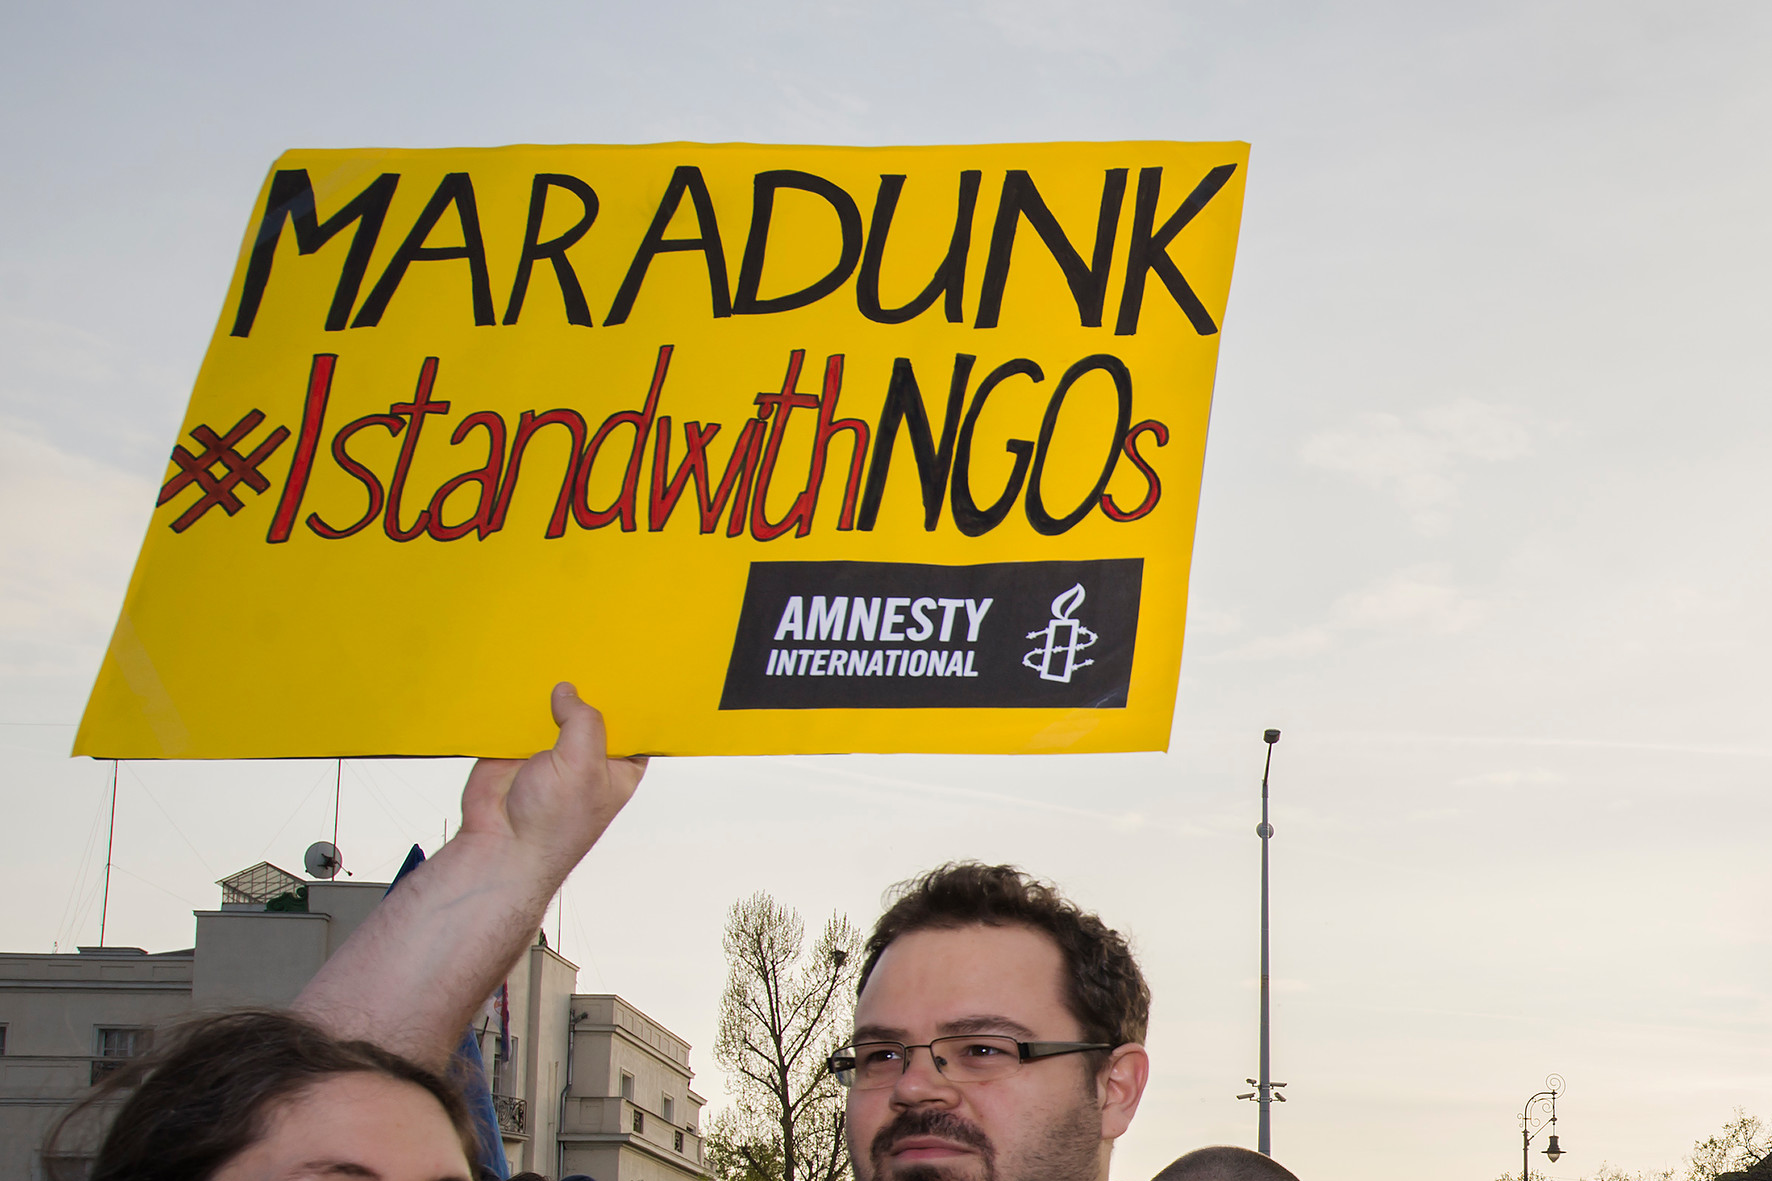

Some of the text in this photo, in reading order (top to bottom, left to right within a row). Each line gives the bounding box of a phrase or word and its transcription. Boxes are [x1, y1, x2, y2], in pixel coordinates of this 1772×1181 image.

[230, 163, 1239, 337] MARADUNK
[155, 344, 1170, 544] #IstandwithNGOs
[765, 646, 980, 678] INTERNATIONAL
[774, 595, 994, 643] AMNESTY
